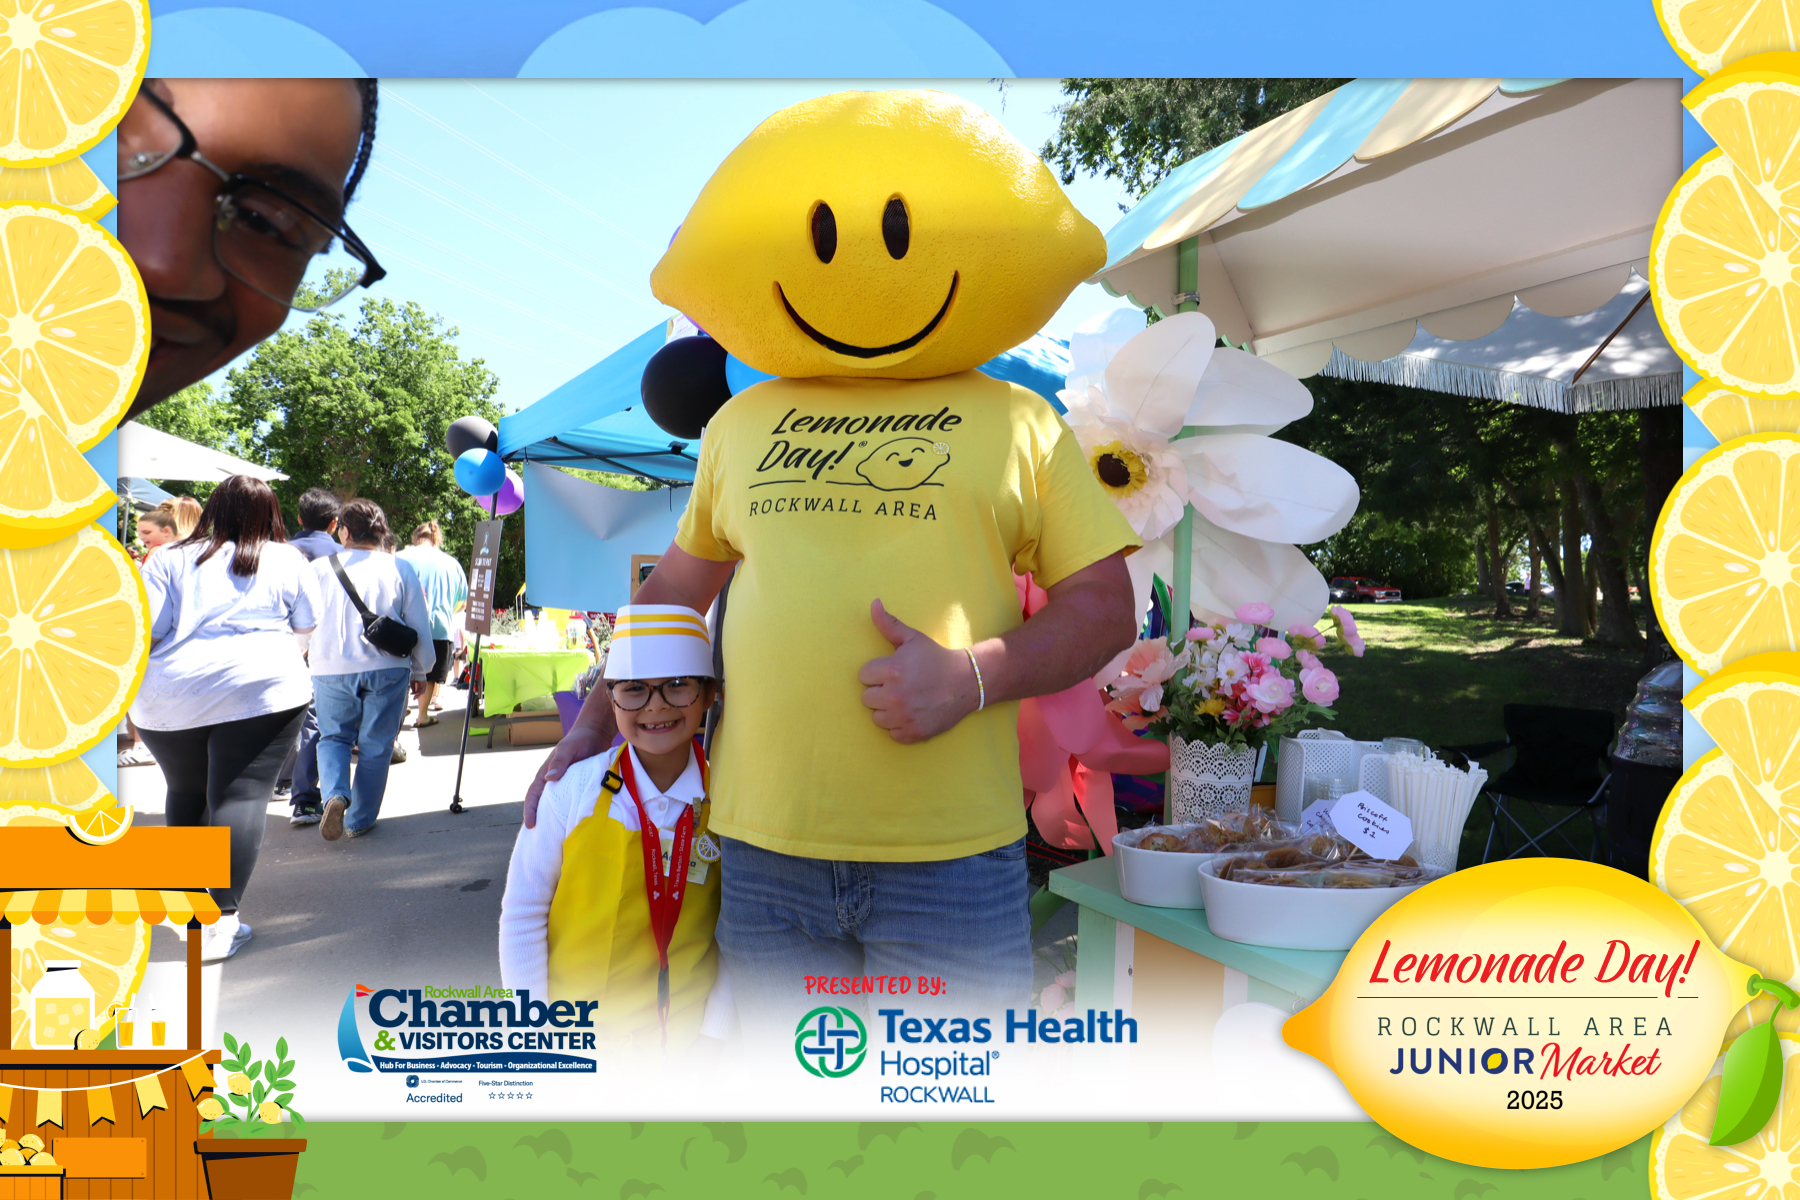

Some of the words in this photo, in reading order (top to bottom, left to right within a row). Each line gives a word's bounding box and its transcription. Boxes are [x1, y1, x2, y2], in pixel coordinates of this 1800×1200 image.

[771, 406, 962, 435] Lemonade
[749, 498, 862, 516] ROCKWALL
[874, 500, 937, 520] AREA
